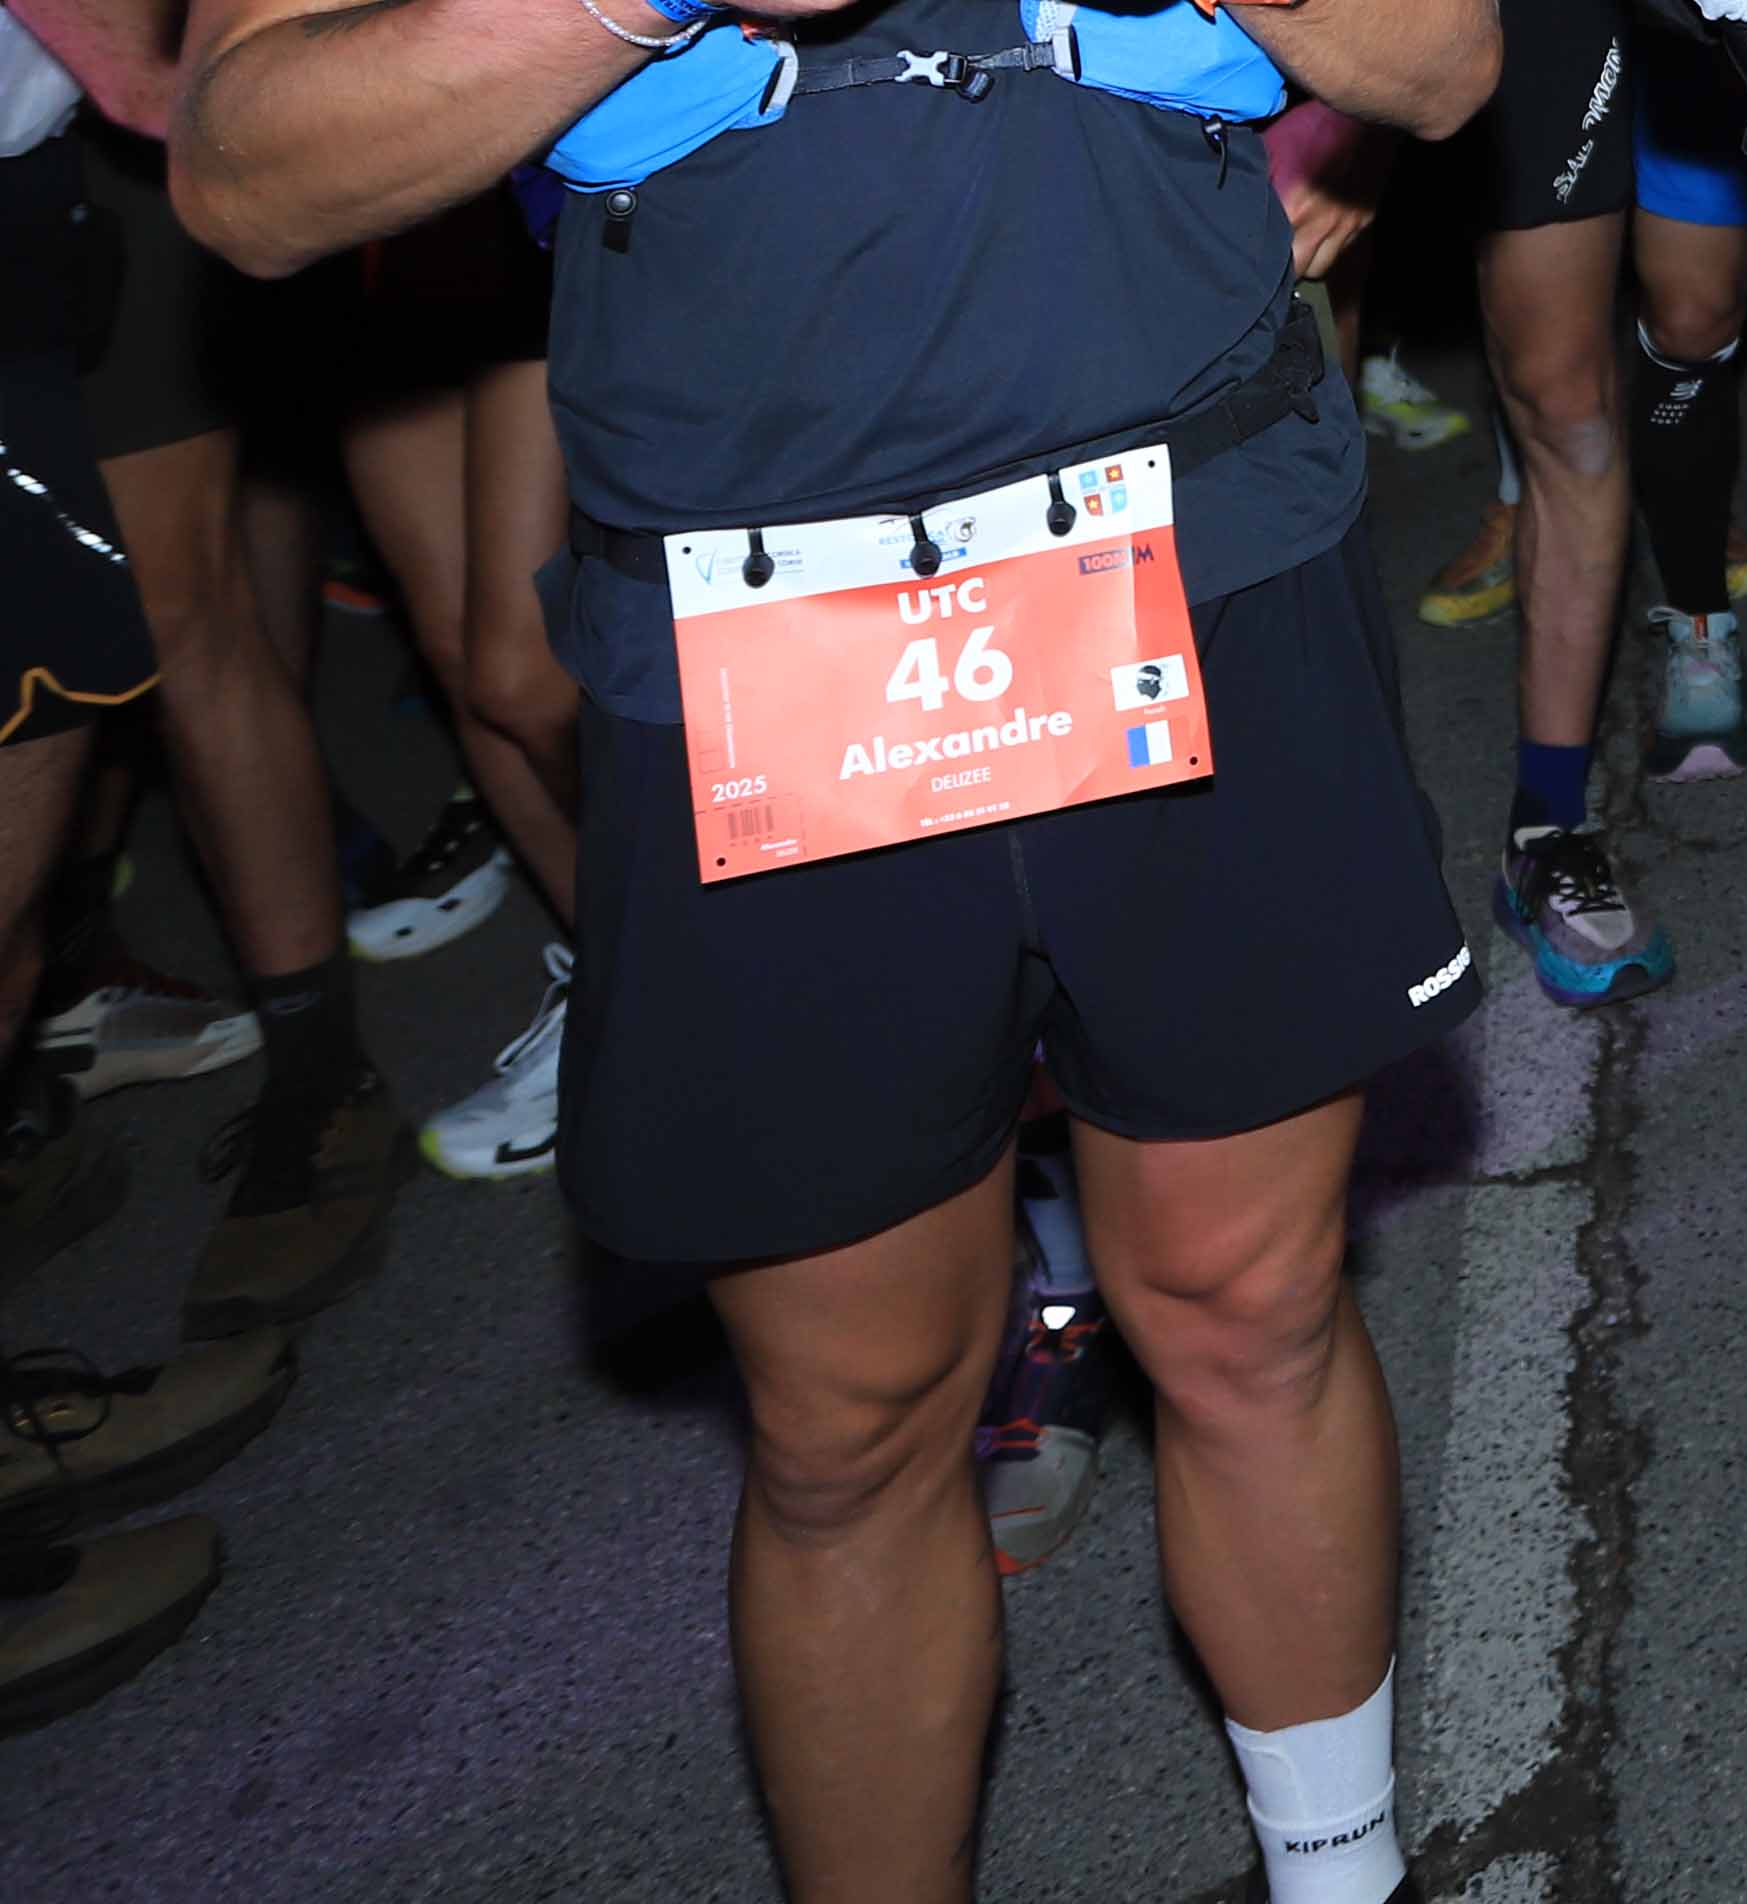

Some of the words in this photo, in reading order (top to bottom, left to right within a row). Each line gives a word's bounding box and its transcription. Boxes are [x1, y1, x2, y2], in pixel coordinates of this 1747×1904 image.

[897, 577, 987, 626] UTC
[886, 625, 1013, 712] 46
[839, 708, 1073, 781] Alexandre
[711, 775, 768, 804] 2025
[1285, 1811, 1385, 1854] KIPRUN
